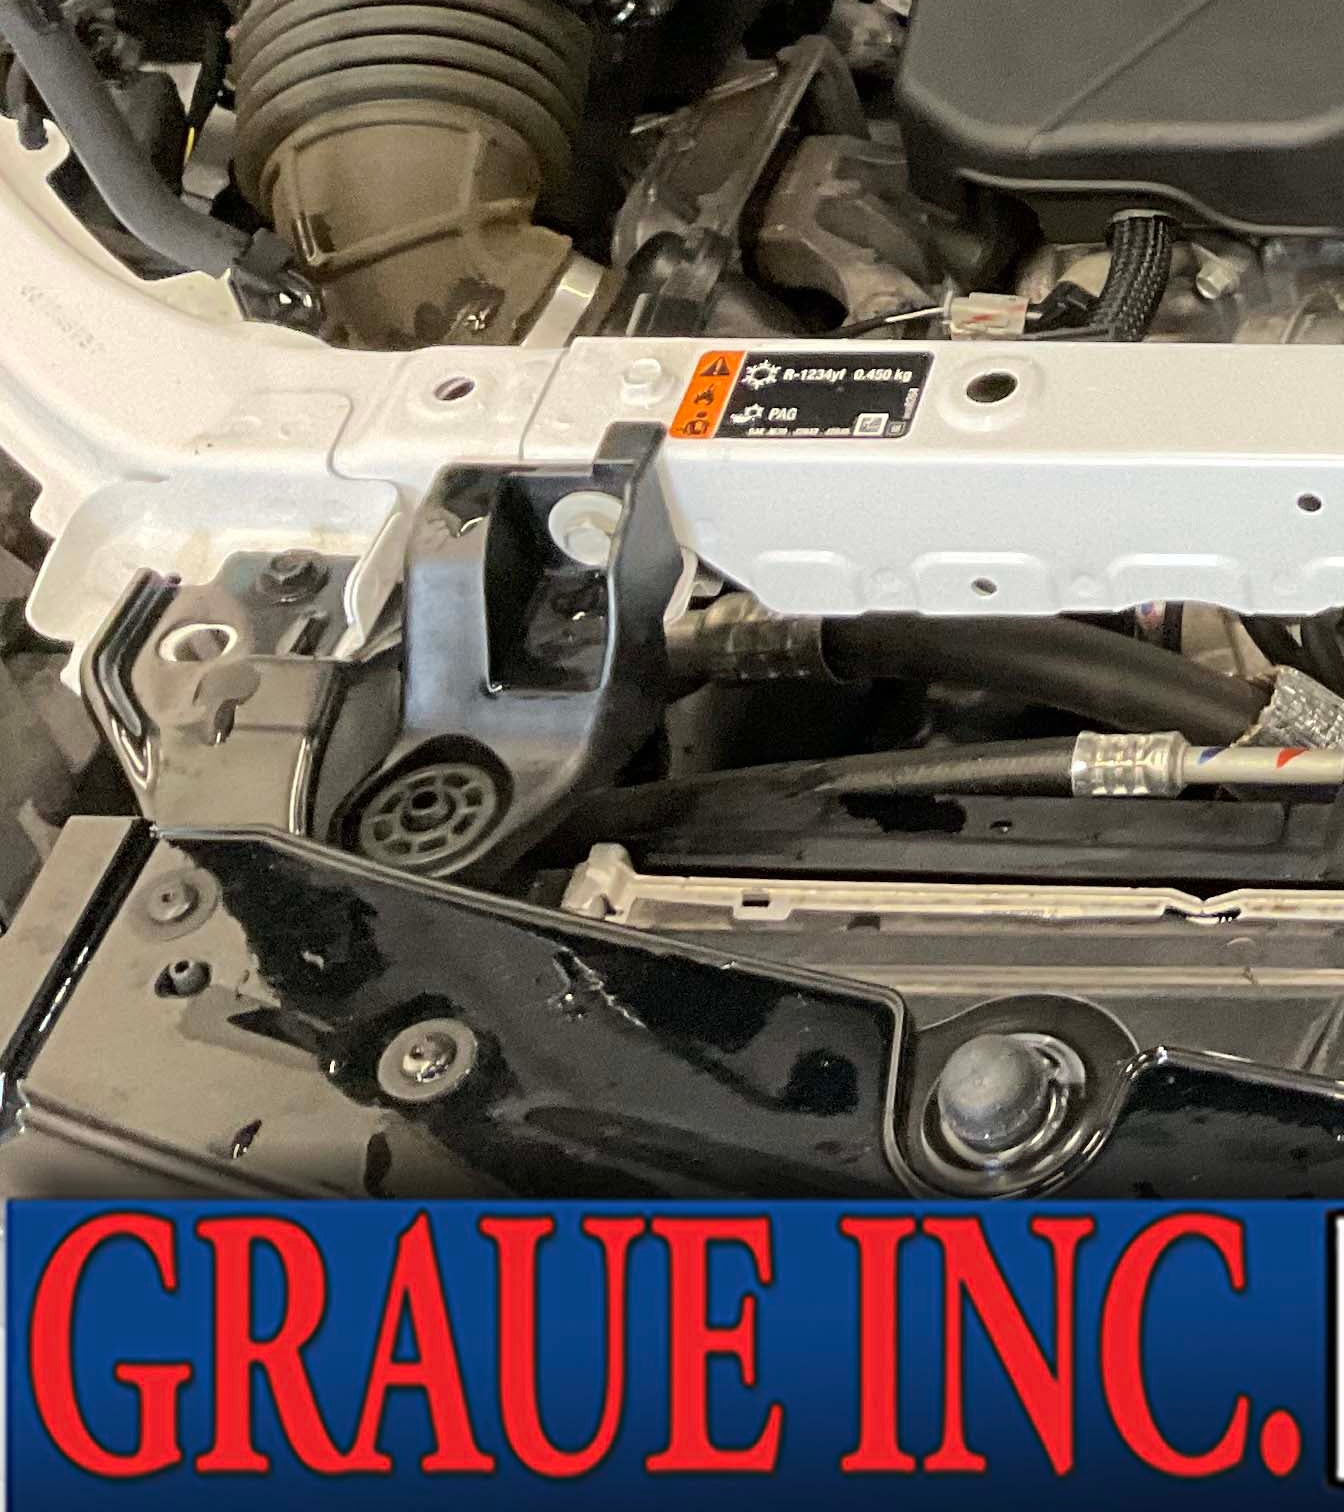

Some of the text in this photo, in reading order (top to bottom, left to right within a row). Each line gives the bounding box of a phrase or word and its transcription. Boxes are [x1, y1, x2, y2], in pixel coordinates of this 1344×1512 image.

[782, 368, 913, 384] R-1234yf 0.450 kg
[767, 407, 798, 421] PAG
